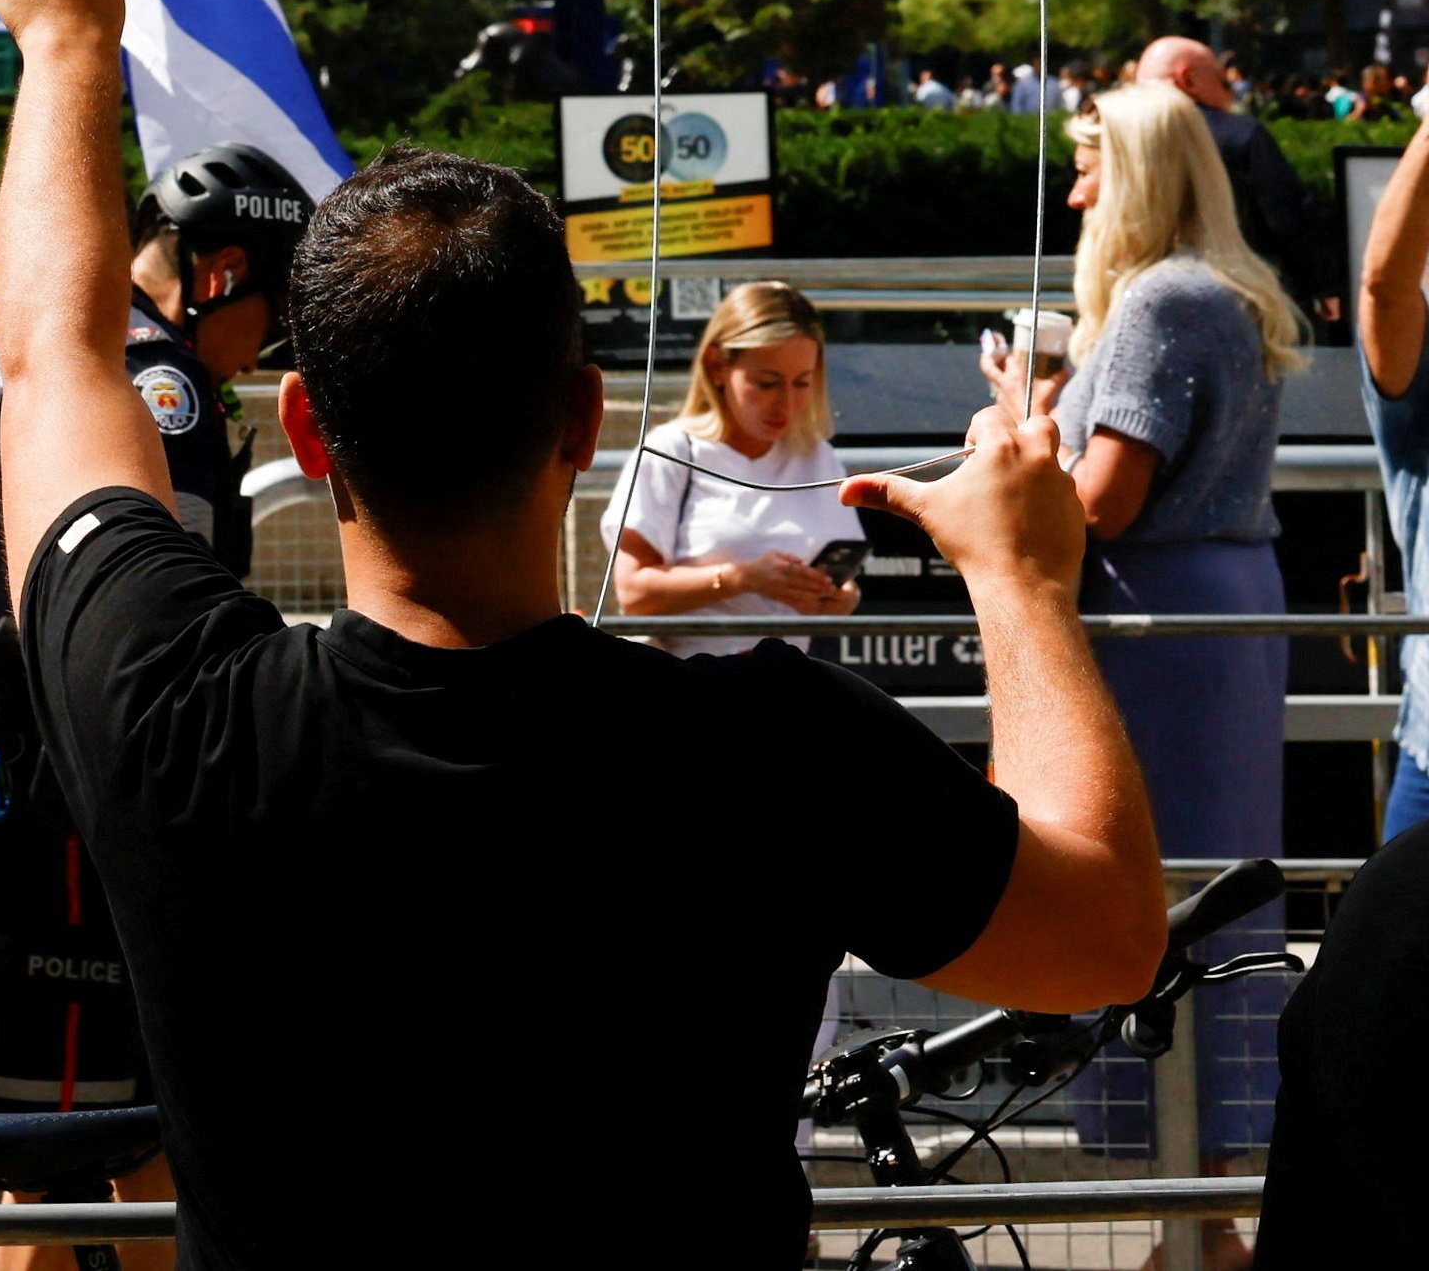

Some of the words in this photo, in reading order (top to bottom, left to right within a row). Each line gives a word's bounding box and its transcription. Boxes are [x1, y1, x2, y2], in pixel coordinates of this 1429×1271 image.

[620, 135, 656, 163] 50
[677, 134, 711, 159] 50
[234, 194, 303, 224] POLICE
[27, 954, 122, 985] POLICE
